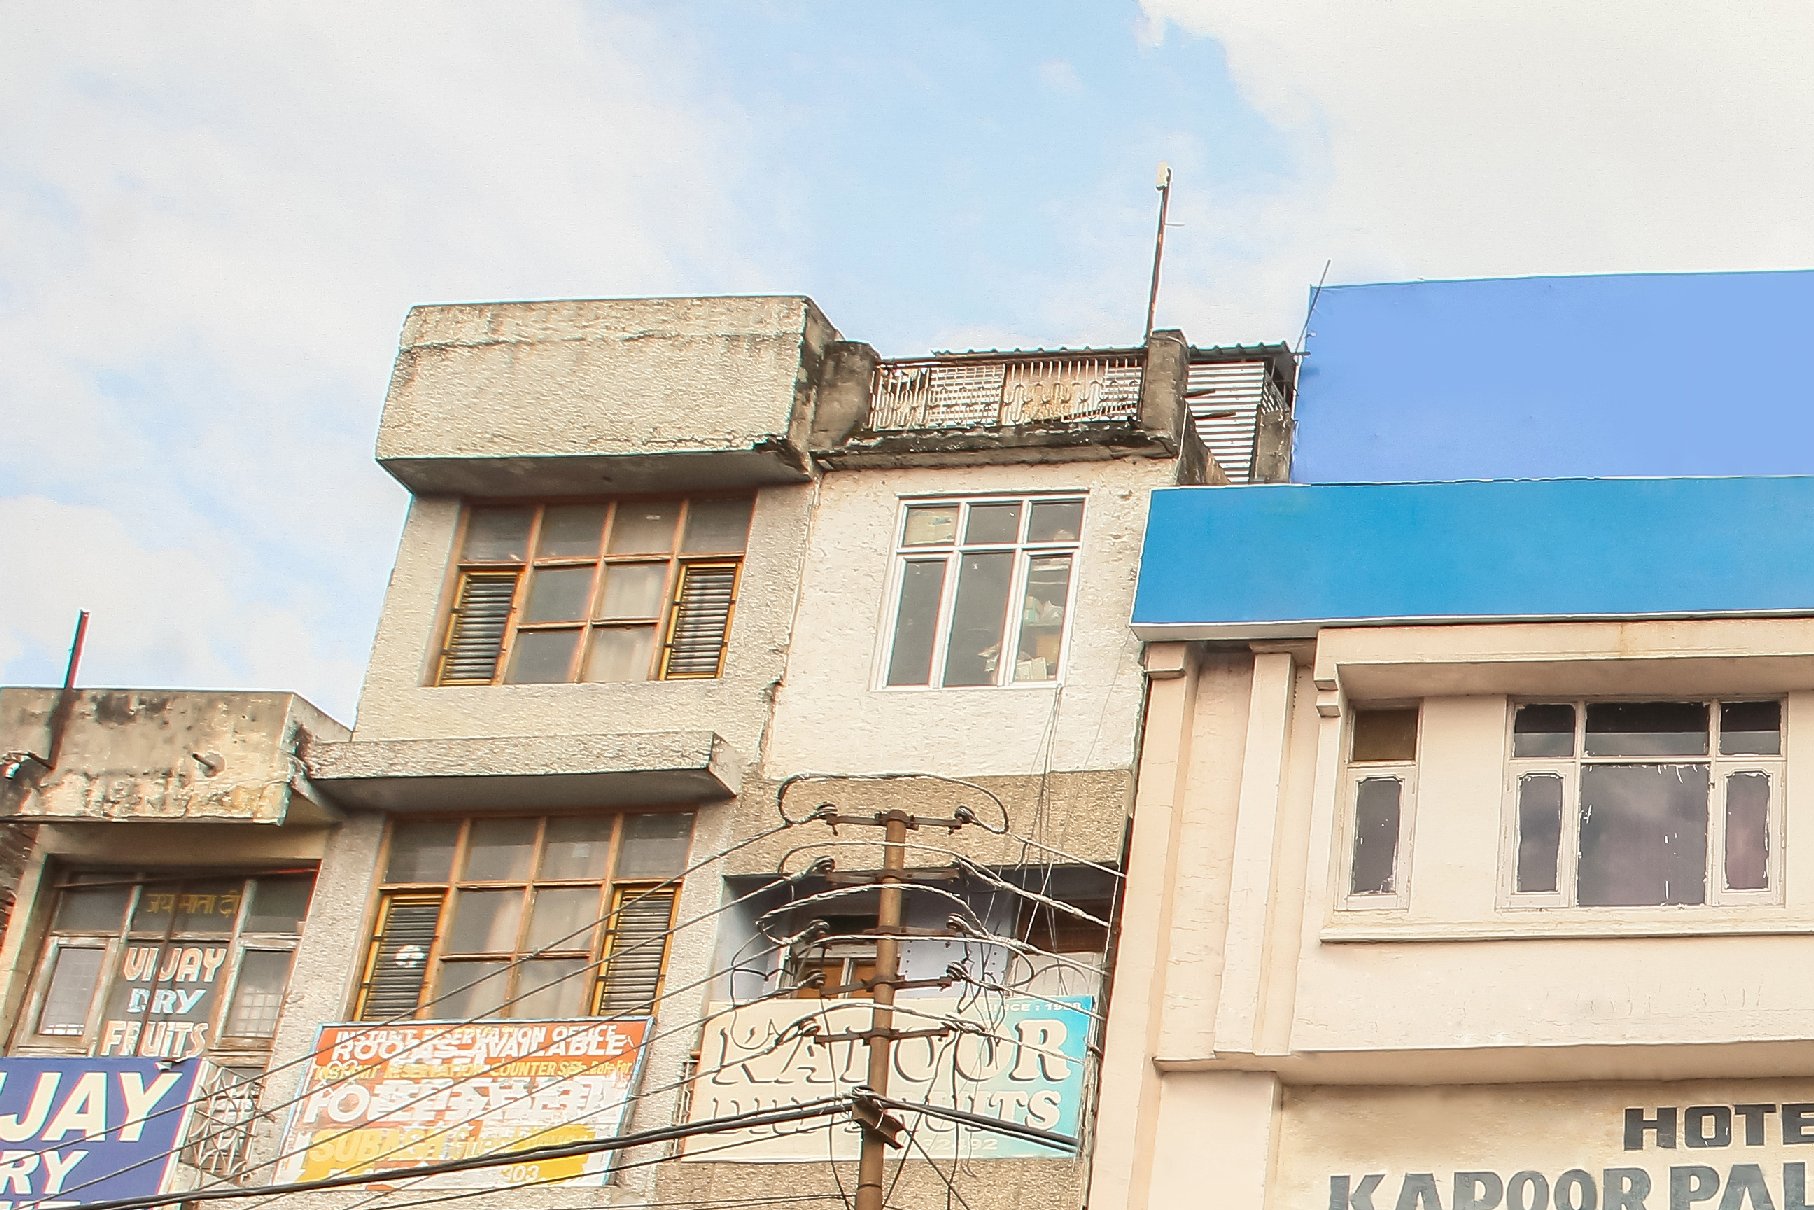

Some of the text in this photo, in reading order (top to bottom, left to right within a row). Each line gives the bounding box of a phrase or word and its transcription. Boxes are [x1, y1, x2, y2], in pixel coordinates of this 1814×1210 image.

[123, 947, 228, 983] VIJAY
[126, 987, 207, 1014] DRY
[0, 1071, 183, 1142] JAY
